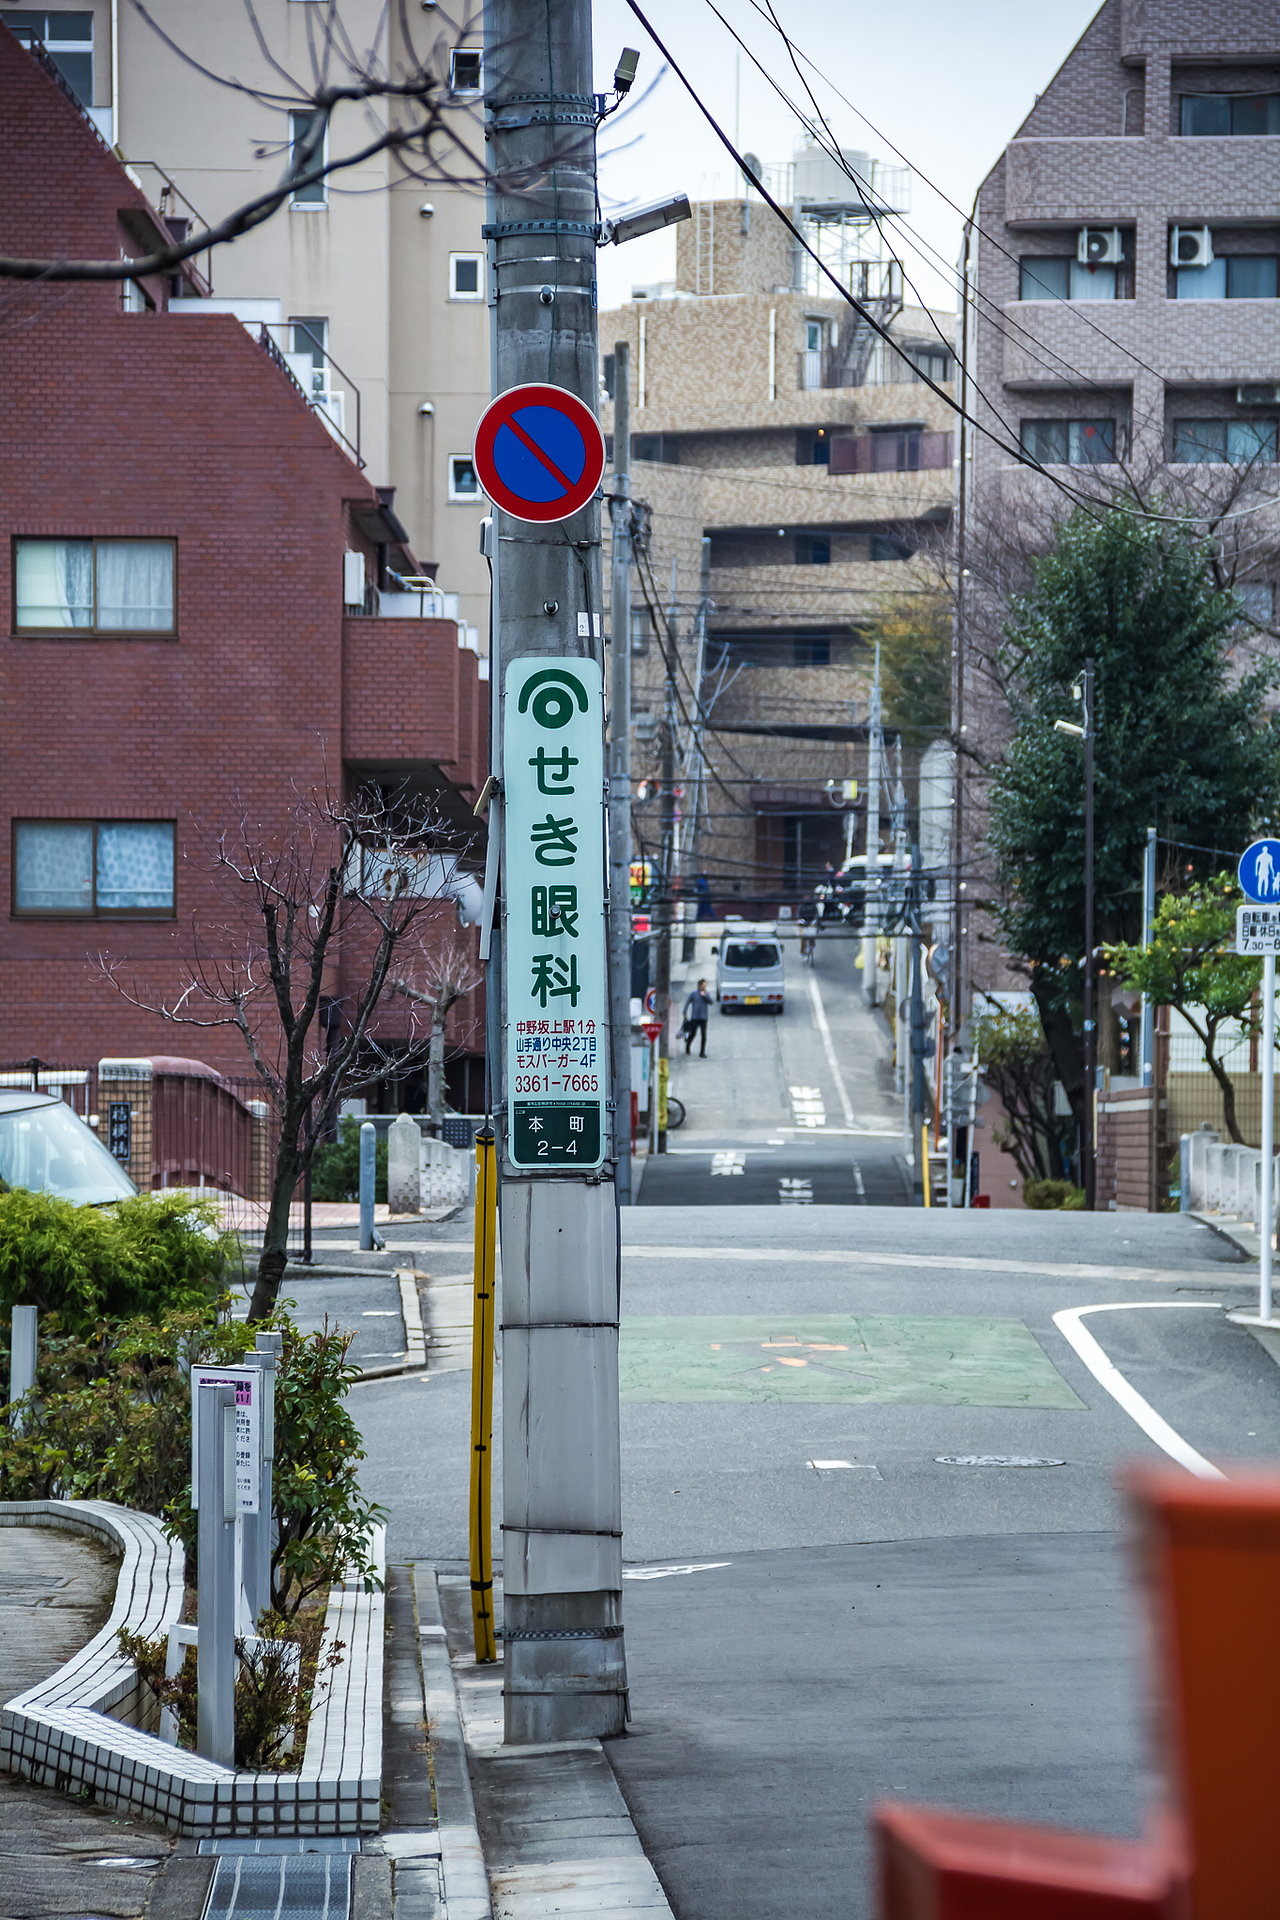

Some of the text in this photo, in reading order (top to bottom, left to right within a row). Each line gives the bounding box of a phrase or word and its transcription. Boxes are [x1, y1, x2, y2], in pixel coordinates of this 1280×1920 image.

[528, 746, 581, 1008] せき眼科
[516, 1020, 596, 1035] 中野坂上駅1分
[516, 1037, 597, 1052] 山手通り中央2丁目
[516, 1054, 597, 1069] モスバーガー4F
[515, 1075, 599, 1092] 3361-7665
[528, 1116, 585, 1133] 本町
[537, 1140, 578, 1156] 2-4
